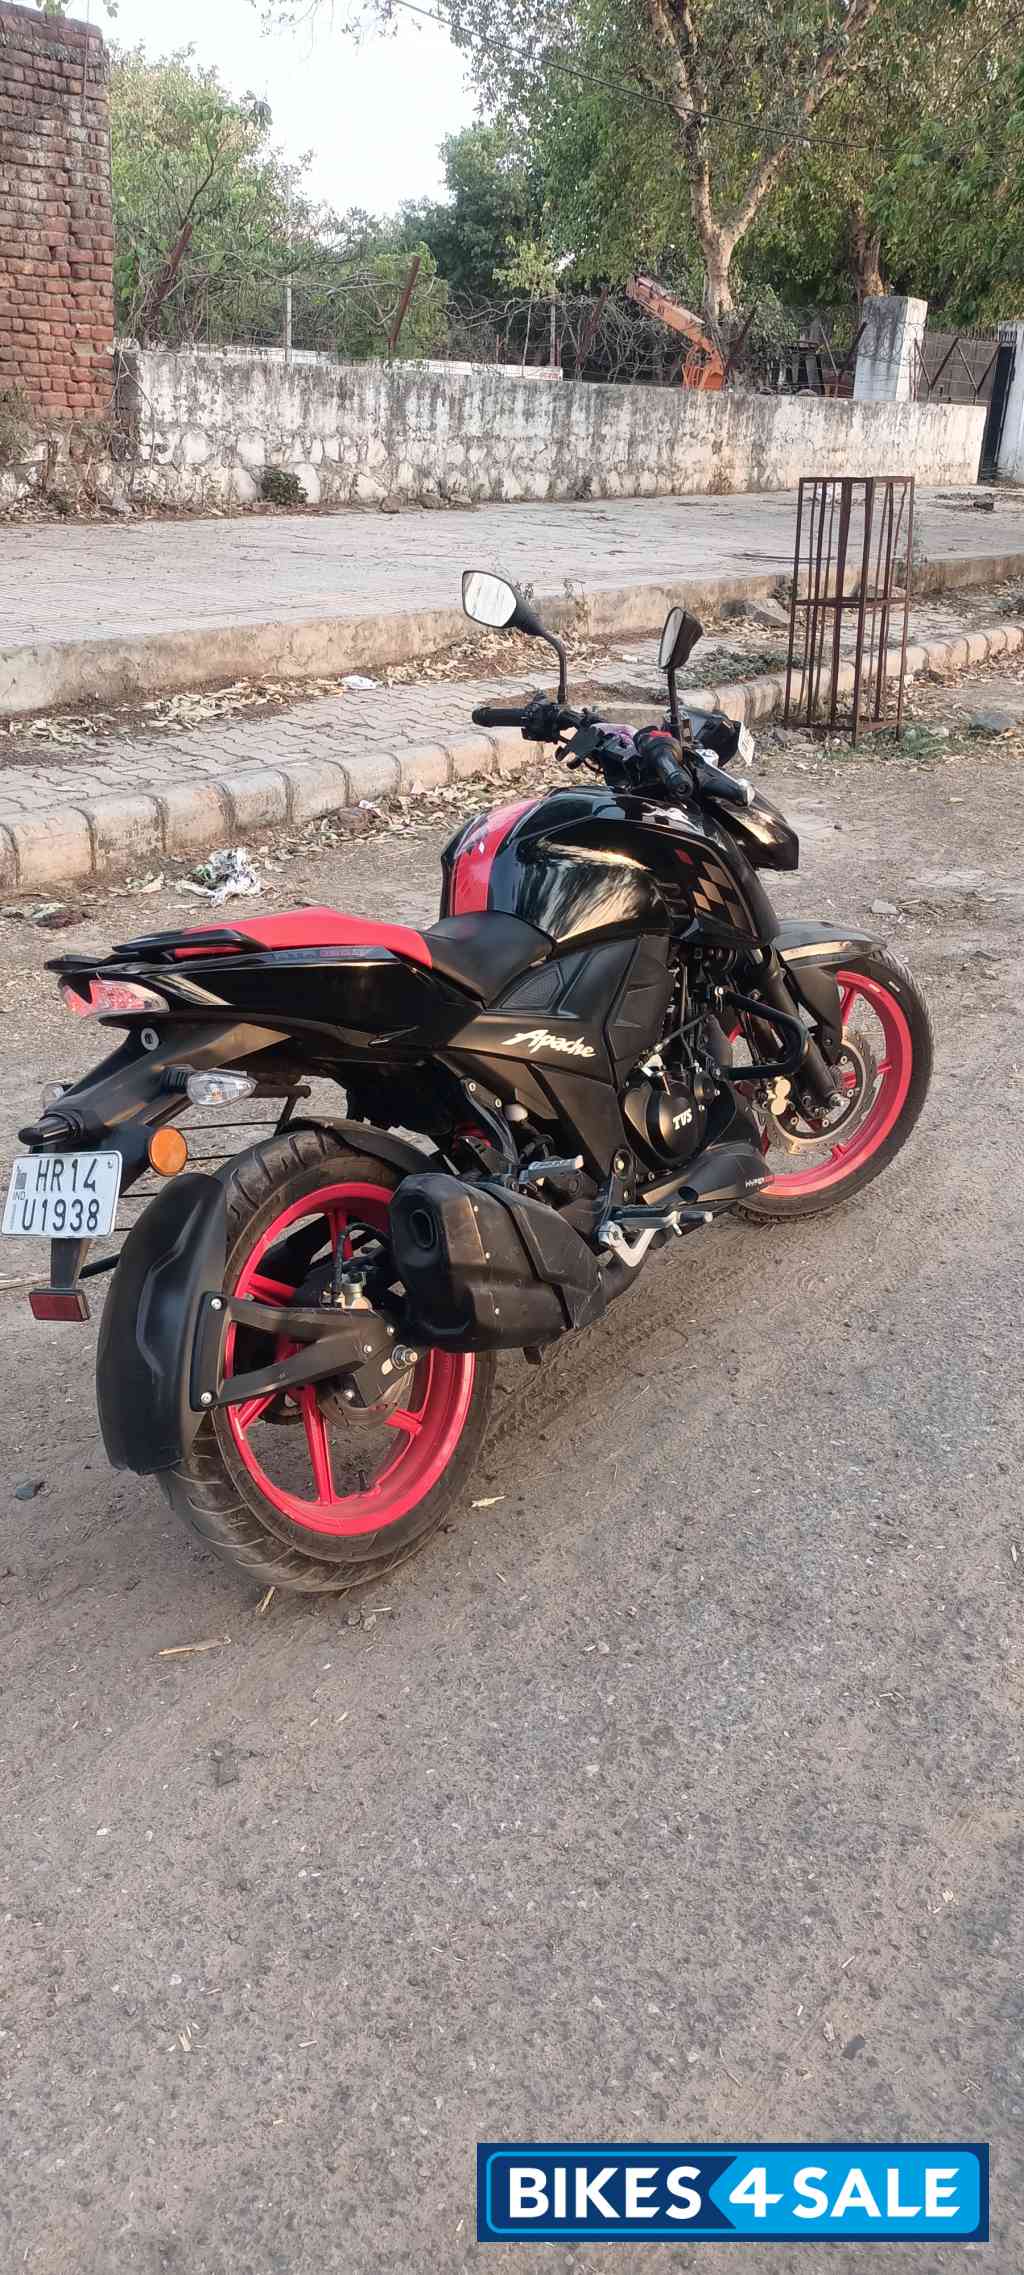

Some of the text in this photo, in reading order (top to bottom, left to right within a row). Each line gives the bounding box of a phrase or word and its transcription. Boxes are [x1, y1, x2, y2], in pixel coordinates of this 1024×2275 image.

[501, 1028, 597, 1058] Apache
[672, 1107, 693, 1131] TVS
[35, 1158, 98, 1192] HR14
[22, 1197, 100, 1232] U1938
